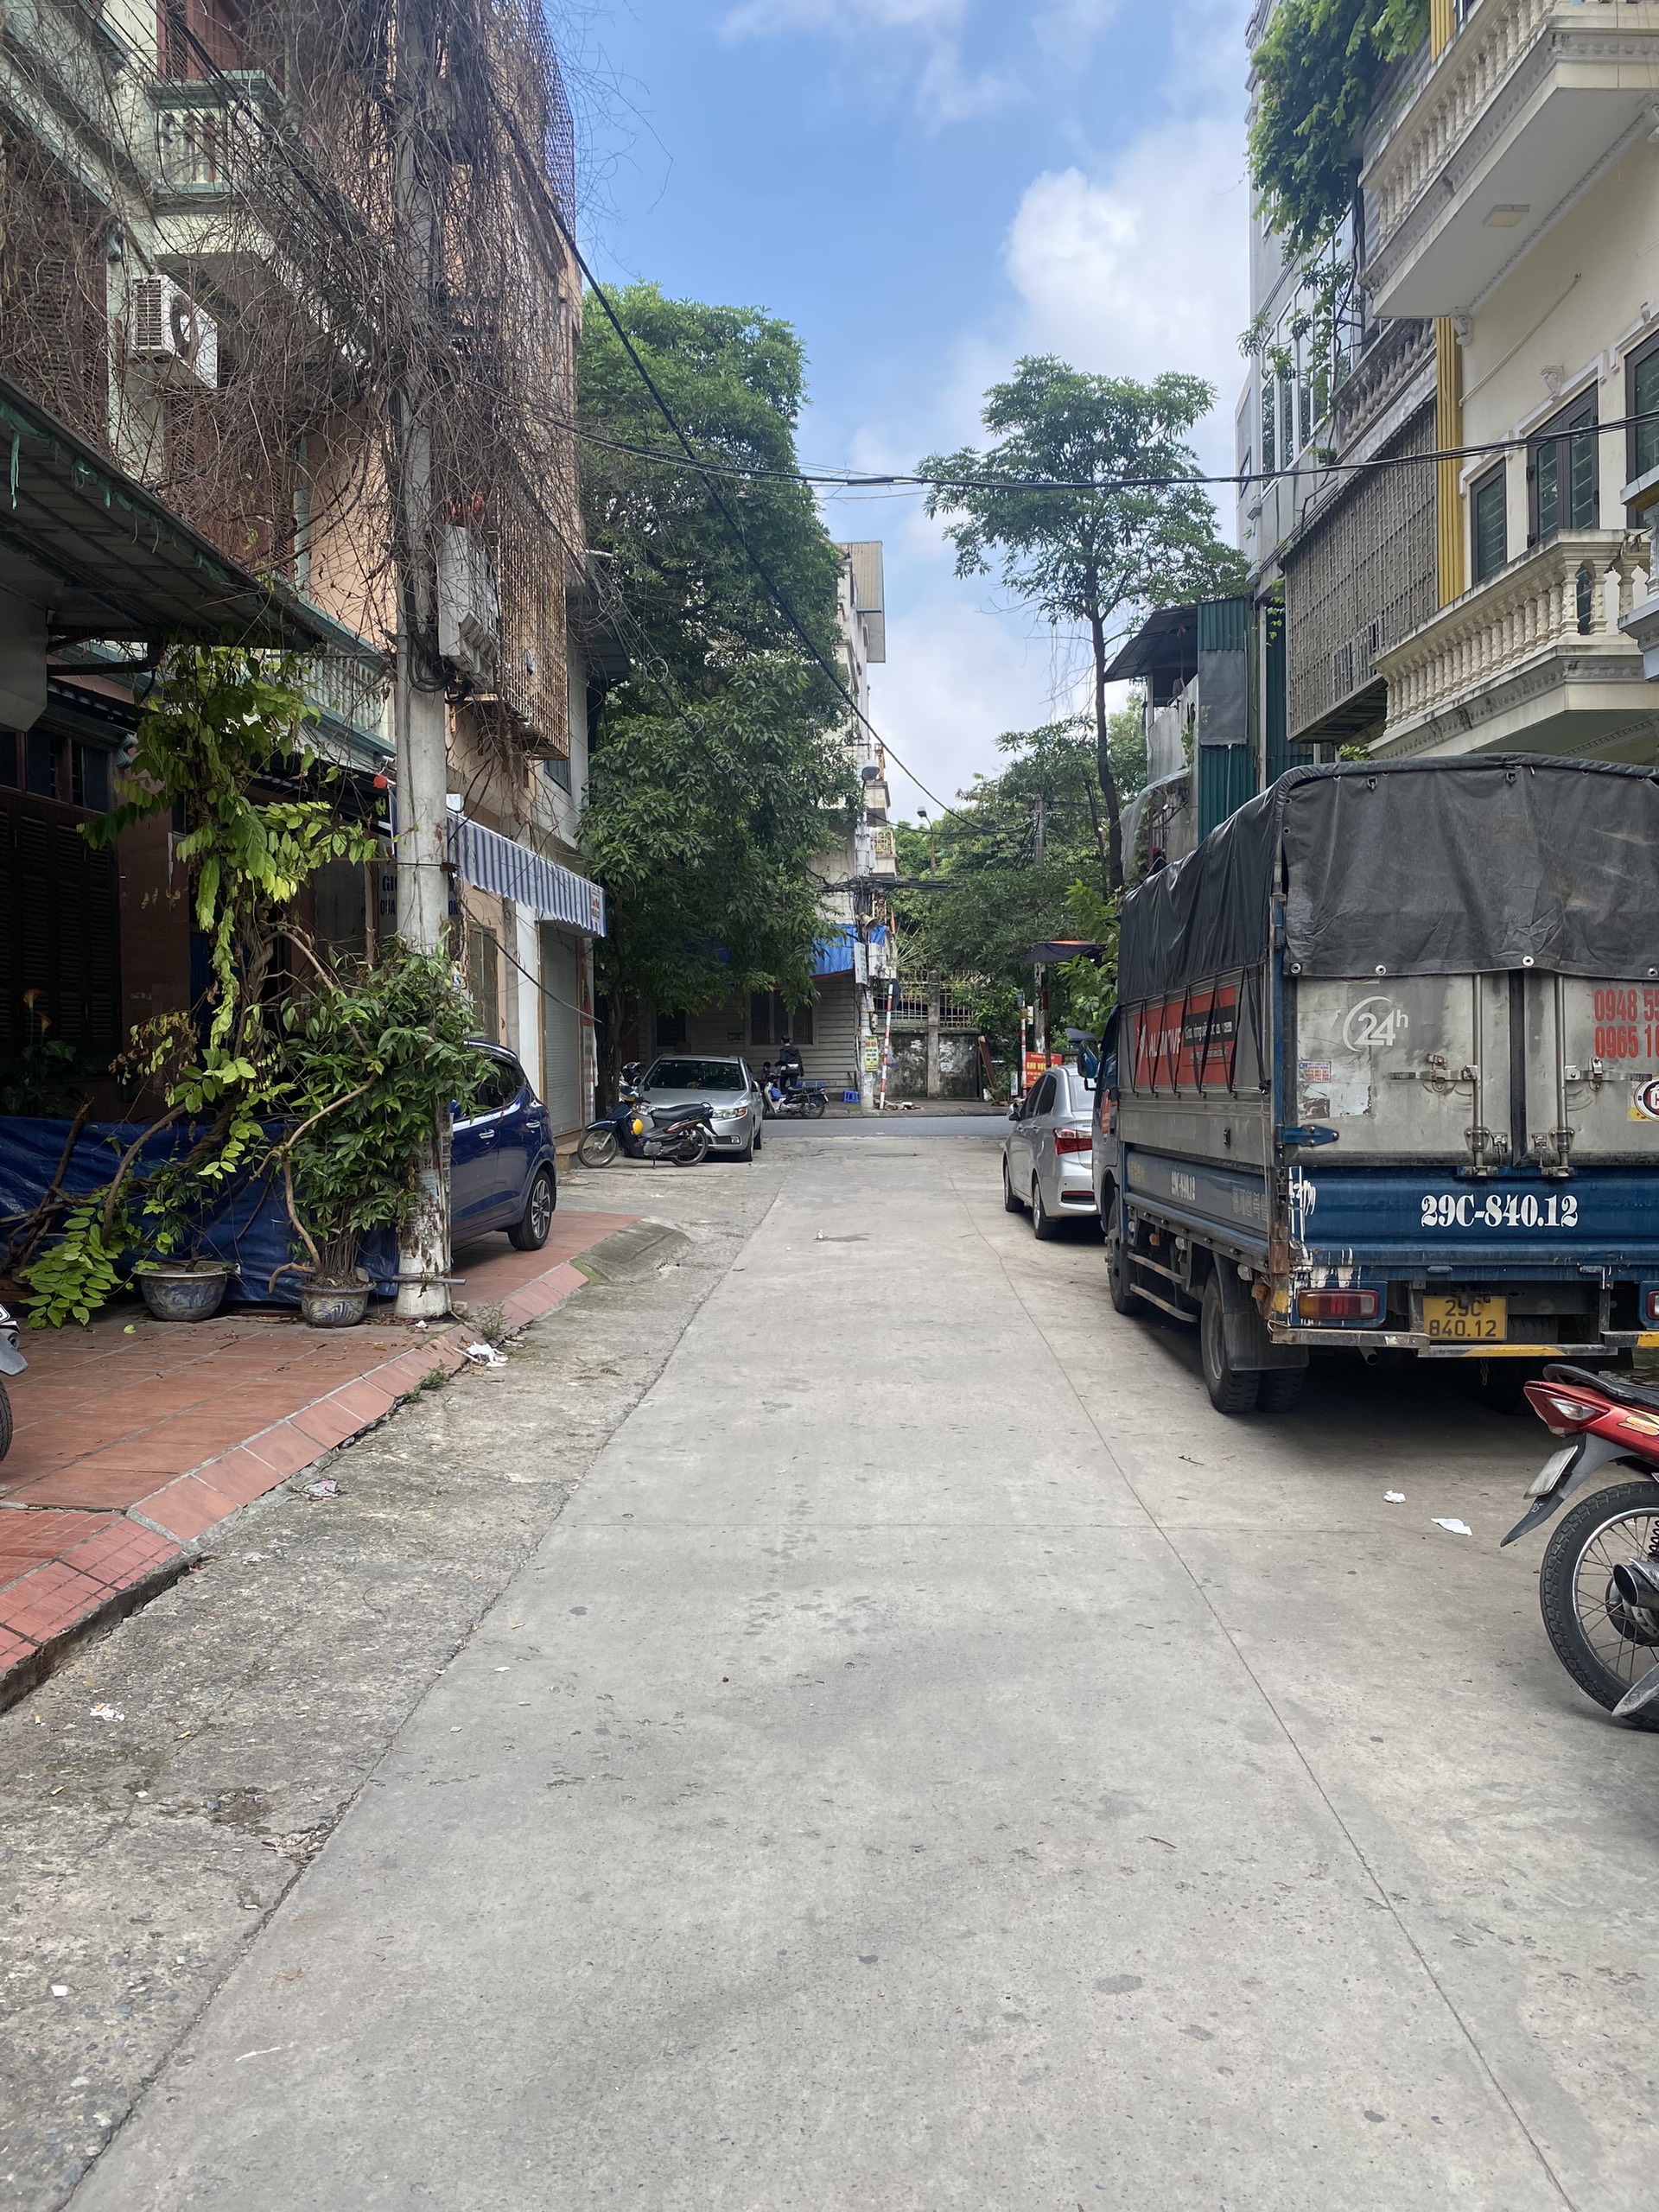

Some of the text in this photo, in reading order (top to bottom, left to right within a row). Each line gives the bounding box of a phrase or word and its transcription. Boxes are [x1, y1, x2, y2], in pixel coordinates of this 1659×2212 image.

[1594, 988, 1638, 1021] 0948
[1353, 1009, 1408, 1046] 24h
[1595, 1026, 1639, 1058] 0965
[1421, 1194, 1578, 1227] 29C-840.12
[1445, 1299, 1482, 1317] 29C
[1428, 1319, 1497, 1338] 840.12
